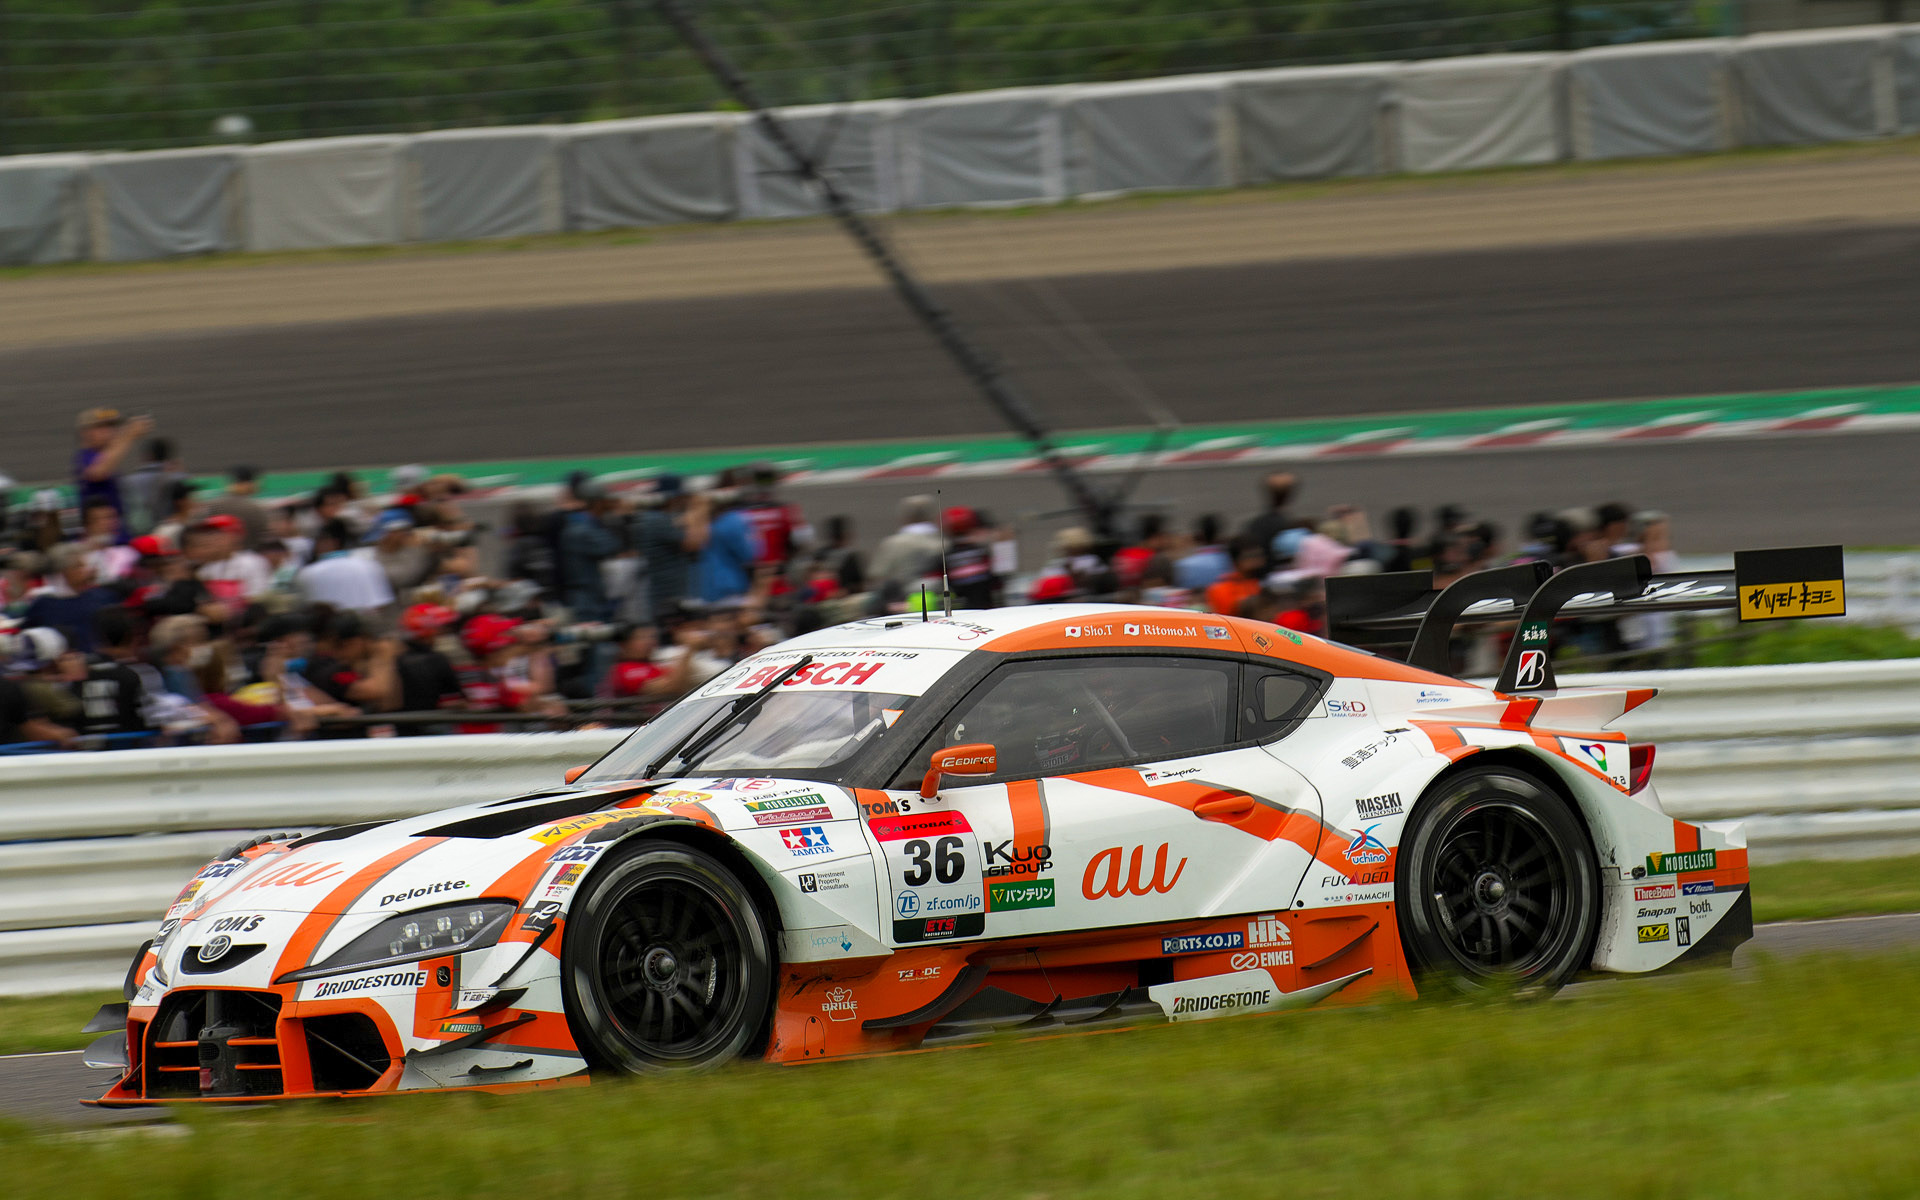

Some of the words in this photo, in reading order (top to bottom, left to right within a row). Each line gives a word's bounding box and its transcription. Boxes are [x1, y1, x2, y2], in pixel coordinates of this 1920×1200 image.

[1084, 624, 1113, 637] Sho.T
[1142, 624, 1198, 637] Ritomo.M
[858, 650, 920, 660] Racing
[735, 662, 886, 690] BOSCH
[1327, 700, 1366, 713] S&D
[955, 756, 996, 766] EDIFICE
[1160, 768, 1202, 778] Supra
[763, 795, 822, 810] MODELLISTA
[862, 798, 911, 816] TOM'S
[1355, 792, 1402, 815] MASEKI
[893, 819, 963, 833] AUTOBACS
[790, 845, 835, 857] TAMIYA
[1352, 851, 1386, 864] uchino
[903, 836, 965, 887] 36
[988, 861, 1054, 877] GROUP
[1665, 853, 1715, 872] MODELLISTA
[241, 861, 345, 892] au
[817, 871, 846, 879] Investment
[1081, 842, 1188, 900] au
[819, 878, 841, 886] Property
[820, 883, 850, 891] Consultants
[379, 880, 471, 907] Deloitte.
[1006, 887, 1053, 903] バンテリン
[1355, 891, 1390, 901] TAMACHI
[1635, 885, 1675, 900] ThreeBond
[926, 895, 981, 911] zf.com/jp
[1637, 907, 1677, 918] Snap-on
[206, 915, 266, 935] TOM'S
[926, 918, 956, 932] ETS
[1260, 950, 1293, 967] ENKEI
[314, 972, 427, 998] BRIDGESTONE
[821, 1000, 858, 1012] BRIDE
[1173, 990, 1270, 1014] BRIDGESTONE
